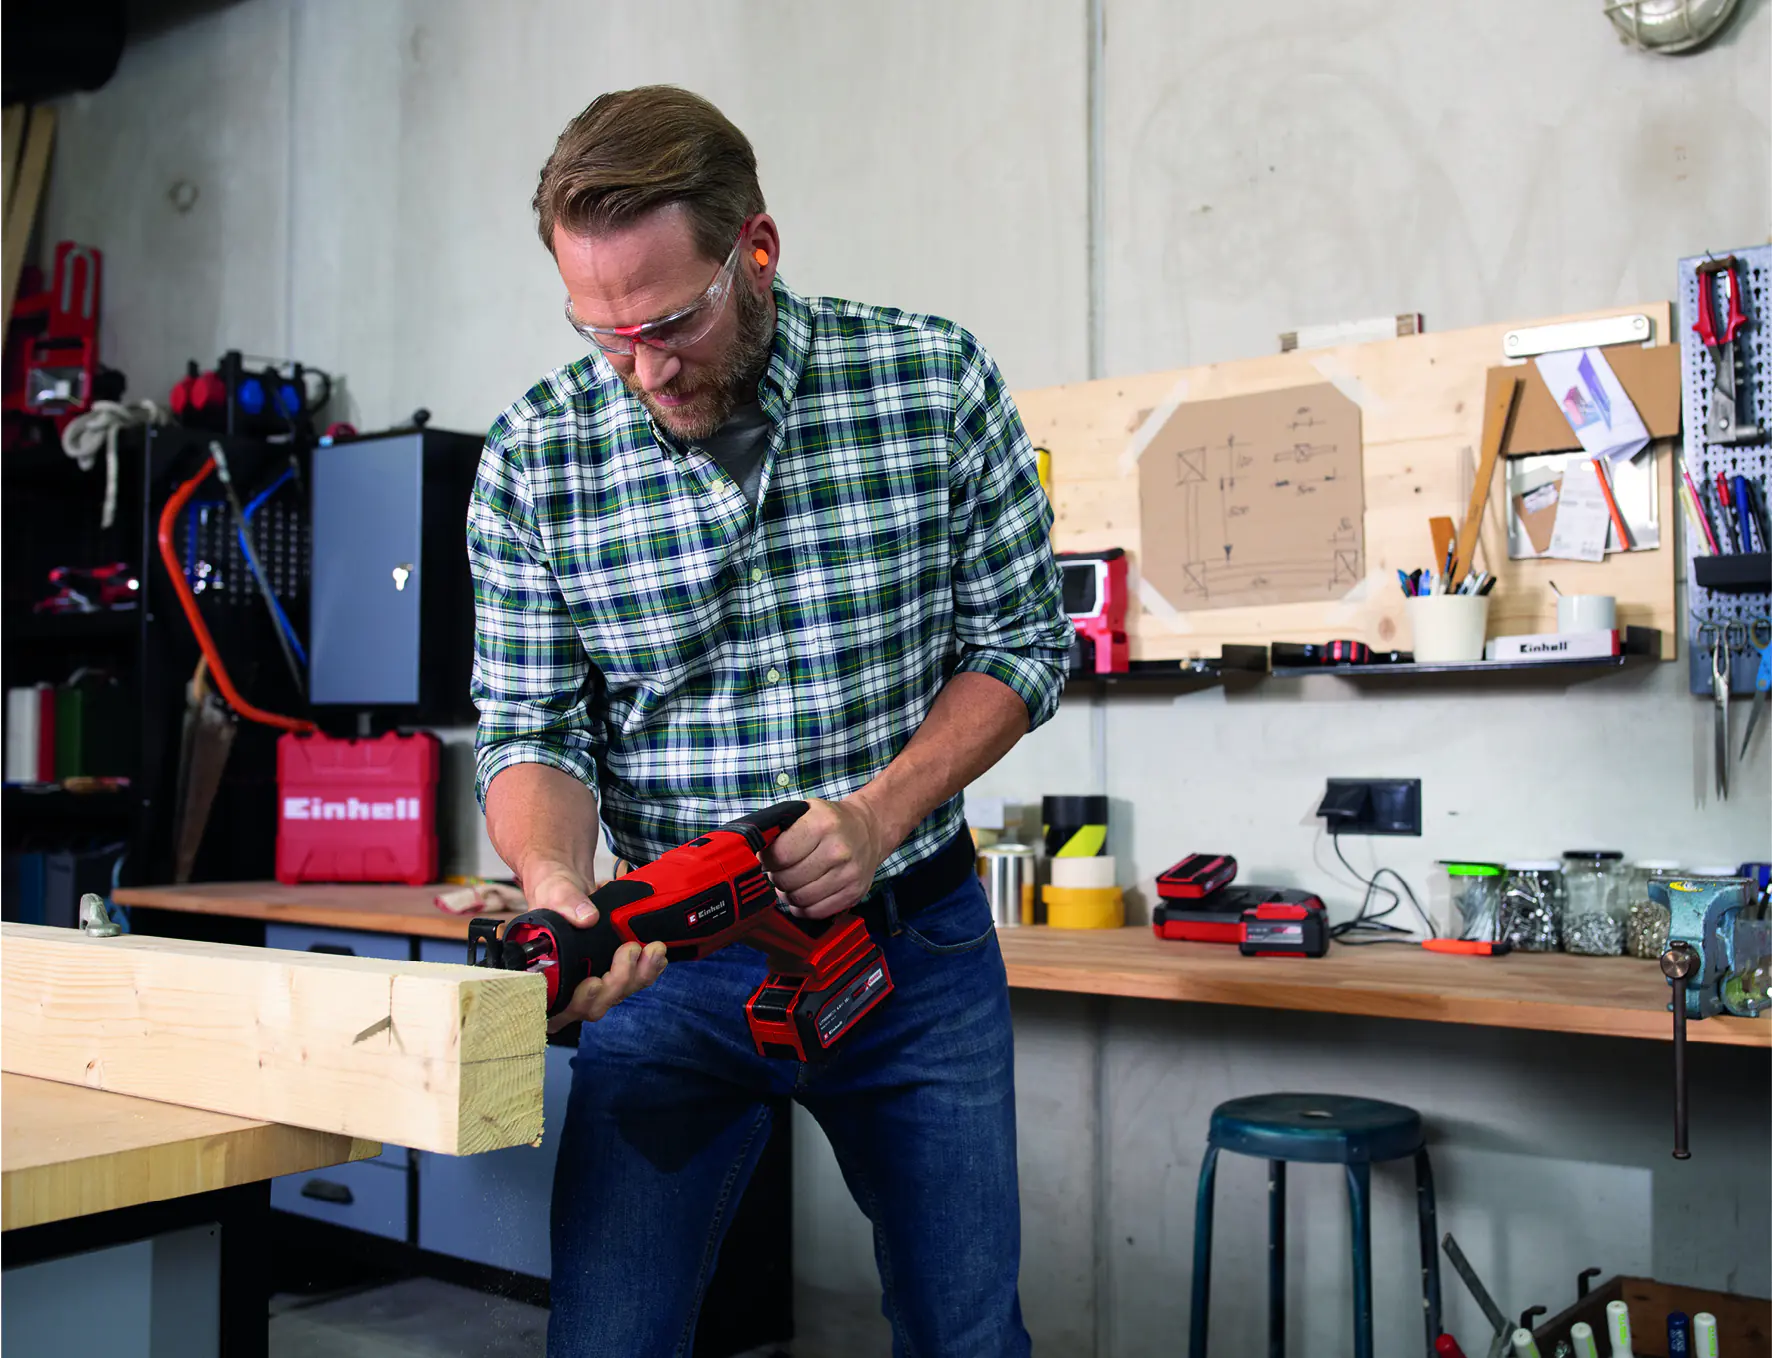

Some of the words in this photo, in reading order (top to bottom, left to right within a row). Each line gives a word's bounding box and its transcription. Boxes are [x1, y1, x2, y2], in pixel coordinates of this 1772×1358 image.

[1520, 641, 1567, 653] Einhell
[284, 798, 420, 820] Einhell
[698, 900, 725, 918] Einhell
